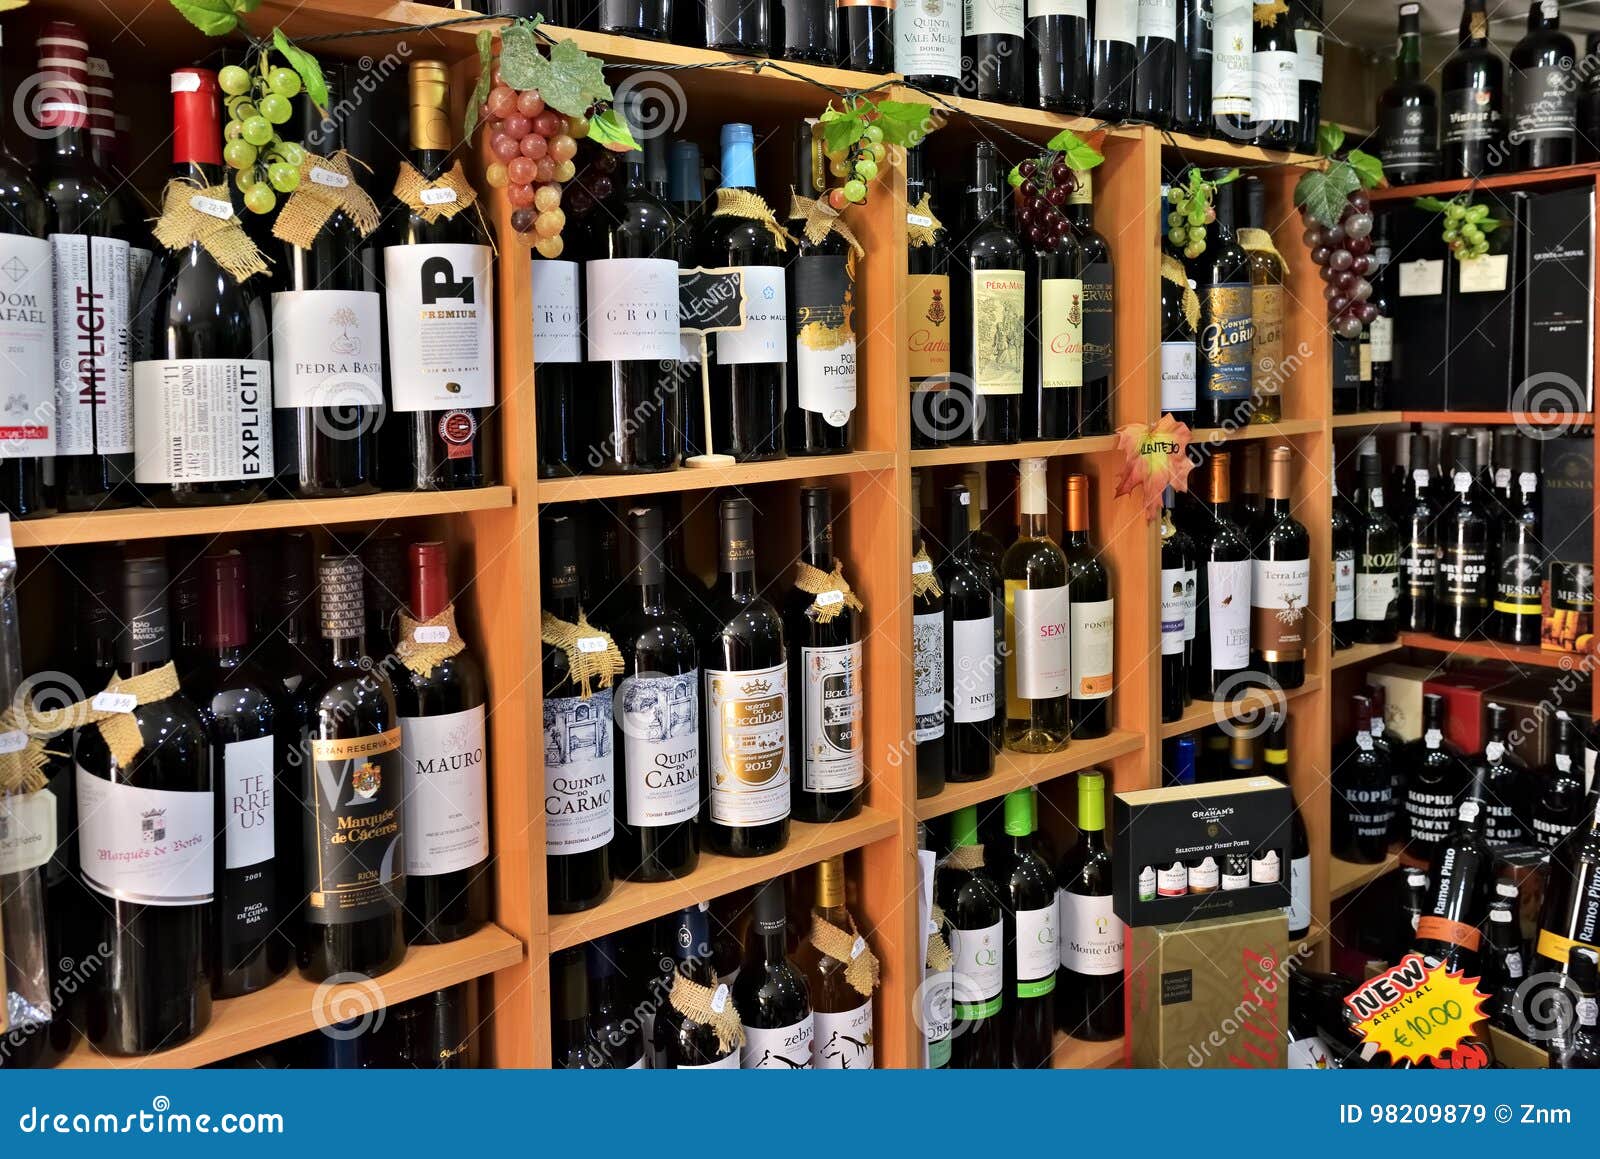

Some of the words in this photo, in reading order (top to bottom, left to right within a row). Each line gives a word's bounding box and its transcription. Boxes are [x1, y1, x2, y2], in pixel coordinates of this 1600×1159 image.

[904, 33, 930, 43] VALE
[1450, 112, 1488, 124] Vintage
[1082, 290, 1113, 301] ERVAS
[0, 308, 46, 324] FAEL
[420, 310, 477, 320] PREMIUM
[76, 286, 106, 405] IMPLICIT
[296, 362, 349, 374] PEDRA
[182, 365, 194, 396] GENUINO
[240, 365, 260, 475] EXPLICIT
[173, 436, 182, 478] FAMILIAR
[1545, 479, 1593, 489] MESSIA
[1265, 571, 1291, 580] Terra
[1440, 563, 1461, 574] DRY
[1464, 565, 1486, 574] OLD
[1447, 572, 1479, 583] PORT
[1497, 583, 1543, 596] MESSIA
[1557, 590, 1593, 602] MESS
[1040, 622, 1066, 637] SEXY
[970, 692, 994, 705] INTEN
[346, 740, 387, 753] RESERVA
[415, 748, 483, 776] MAURO
[655, 749, 697, 769] QUINTA
[676, 763, 685, 771] DO
[744, 761, 773, 773] 2013
[240, 774, 265, 795] TE
[552, 773, 607, 795] QUINTA
[577, 789, 588, 797] DO
[1408, 789, 1453, 805] KOPKE
[232, 790, 271, 815] RRE
[544, 789, 611, 816] CARMO
[1405, 801, 1457, 817] RESERVE
[240, 809, 266, 830] US
[336, 808, 394, 831] Marqués
[1191, 807, 1235, 819] GRAHAM'S
[1410, 815, 1450, 830] TAWNY
[331, 831, 347, 844] de
[348, 821, 398, 844] Cáceres
[1175, 845, 1204, 854] SELECTION
[1440, 847, 1456, 879] Pinto
[245, 872, 262, 882] 2001
[357, 870, 379, 881] RIOJA
[1433, 879, 1450, 915] Ramos
[237, 911, 247, 920] DE
[246, 905, 269, 918] CUEVA
[244, 902, 263, 914] PAGO
[246, 914, 261, 925] BAJA
[1579, 902, 1599, 942] Ramos
[1070, 942, 1102, 955] Monte
[1350, 960, 1426, 1016] NEW
[1372, 985, 1434, 1027] ARRIVAL
[1394, 1028, 1413, 1048] €
[1406, 999, 1463, 1041] 10.00
